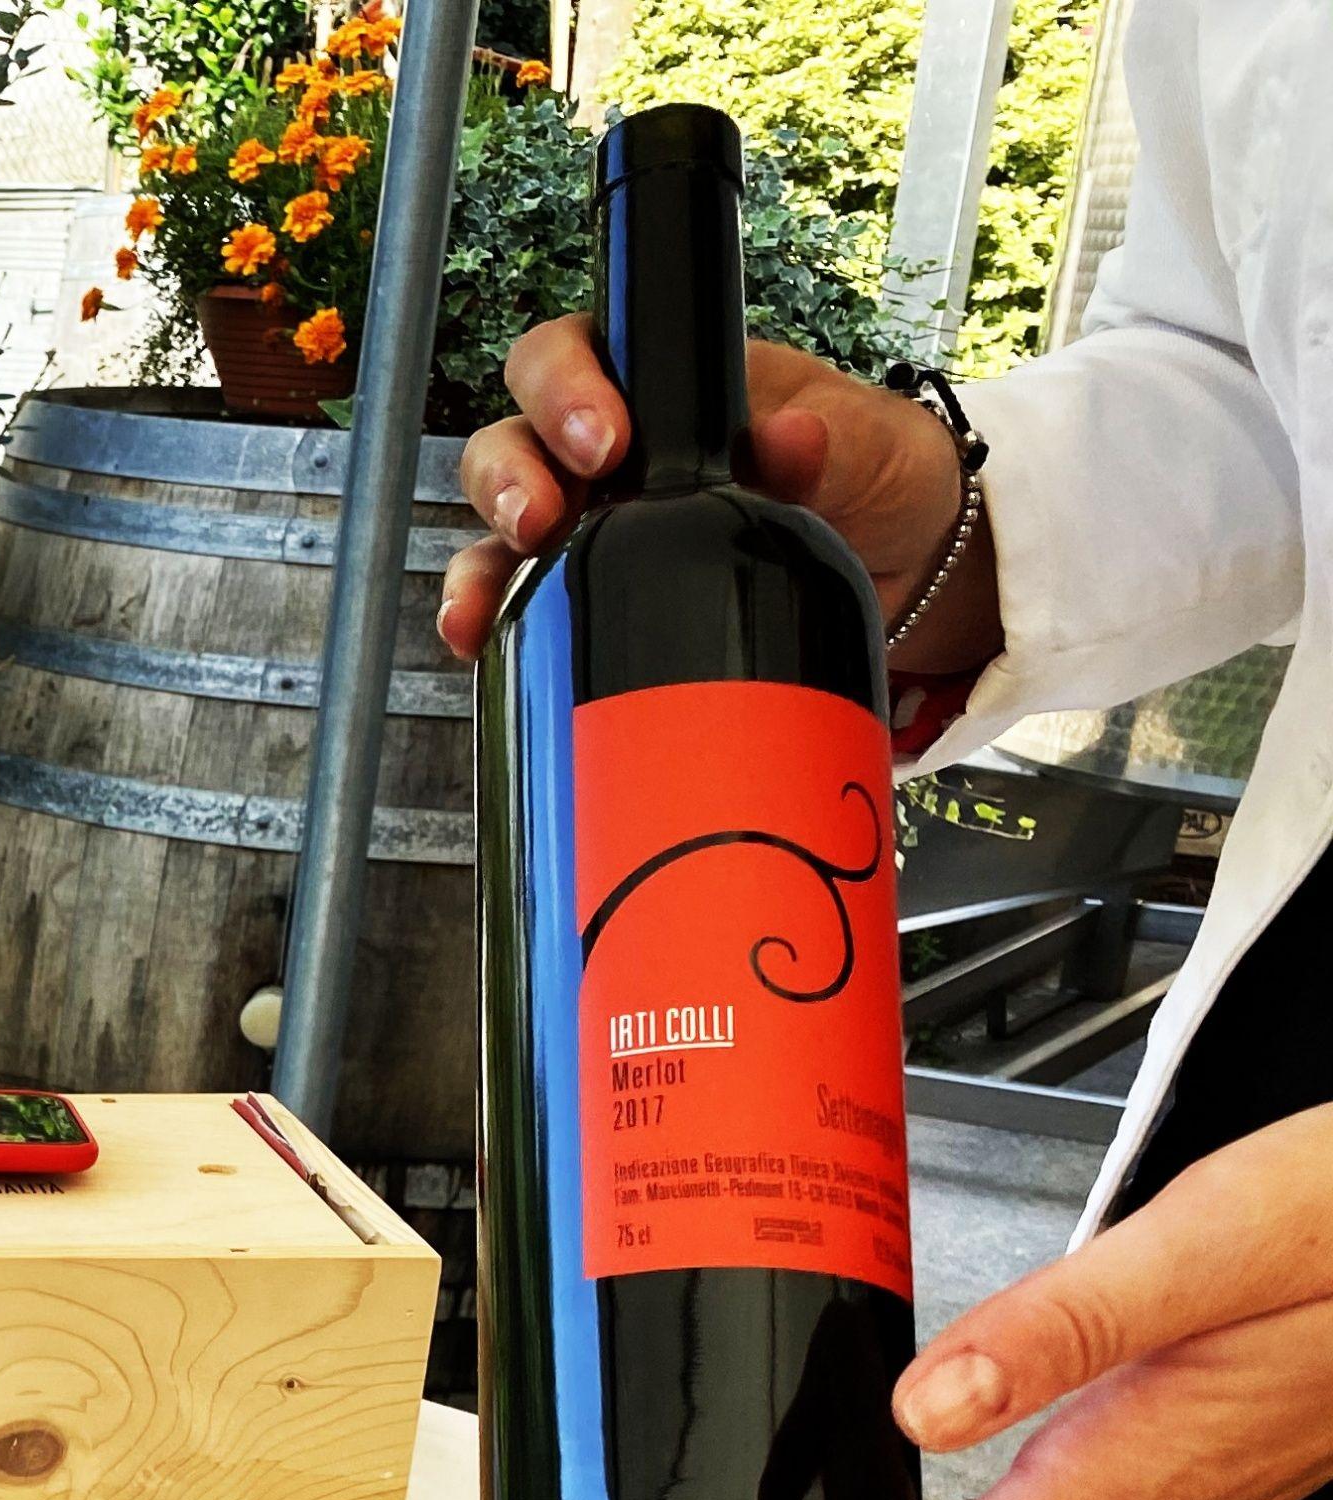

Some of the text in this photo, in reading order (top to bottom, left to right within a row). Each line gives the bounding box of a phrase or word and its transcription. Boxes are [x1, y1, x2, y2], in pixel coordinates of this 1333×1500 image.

[610, 1005, 734, 1052] IRTI COLLI
[612, 1057, 685, 1091] Merlot
[613, 1094, 665, 1131] 2017
[617, 1222, 635, 1248] 75
